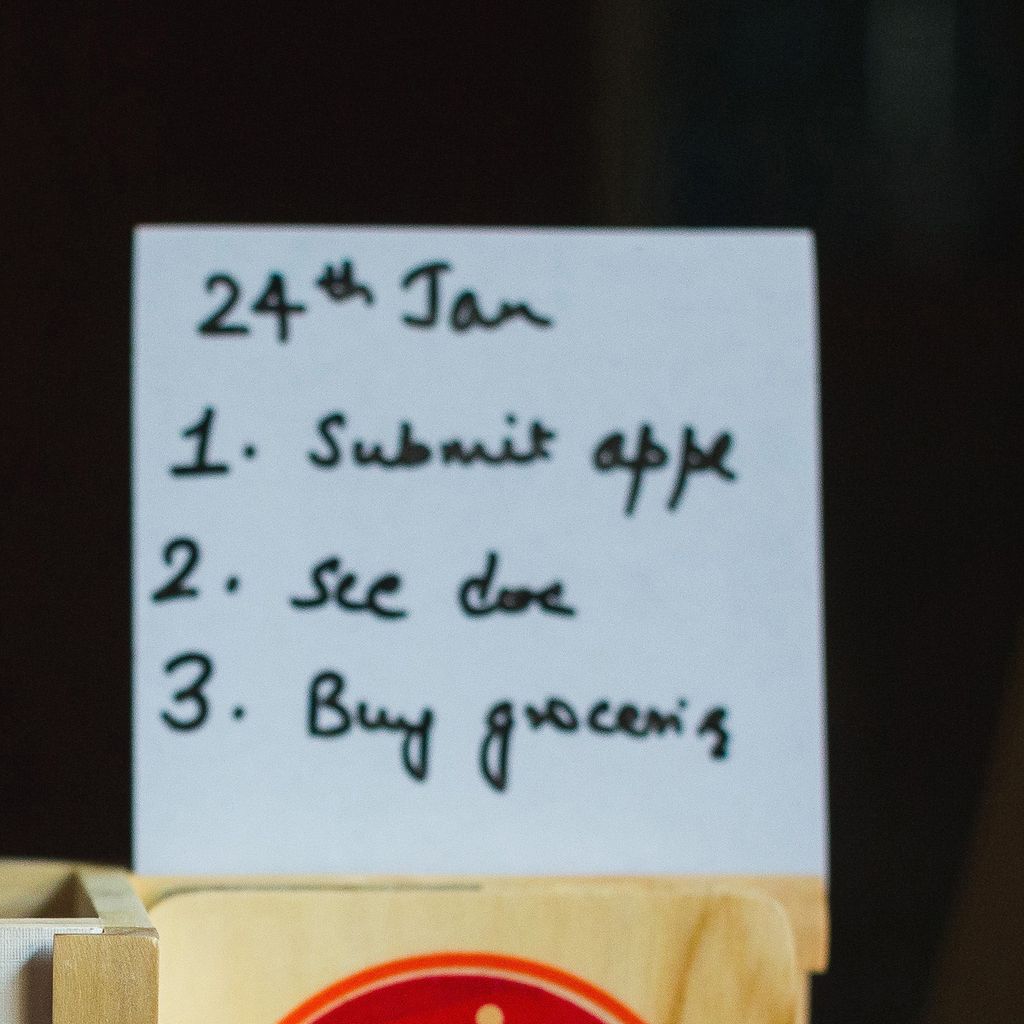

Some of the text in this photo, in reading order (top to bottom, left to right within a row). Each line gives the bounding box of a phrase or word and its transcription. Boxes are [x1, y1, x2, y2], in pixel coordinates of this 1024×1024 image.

[401, 261, 553, 333] Jan
[169, 406, 257, 479] 1.
[308, 411, 556, 470] Submit
[153, 536, 240, 603] 2.
[457, 551, 576, 619] doc
[161, 651, 245, 733] 3.
[306, 669, 435, 783] Buy
